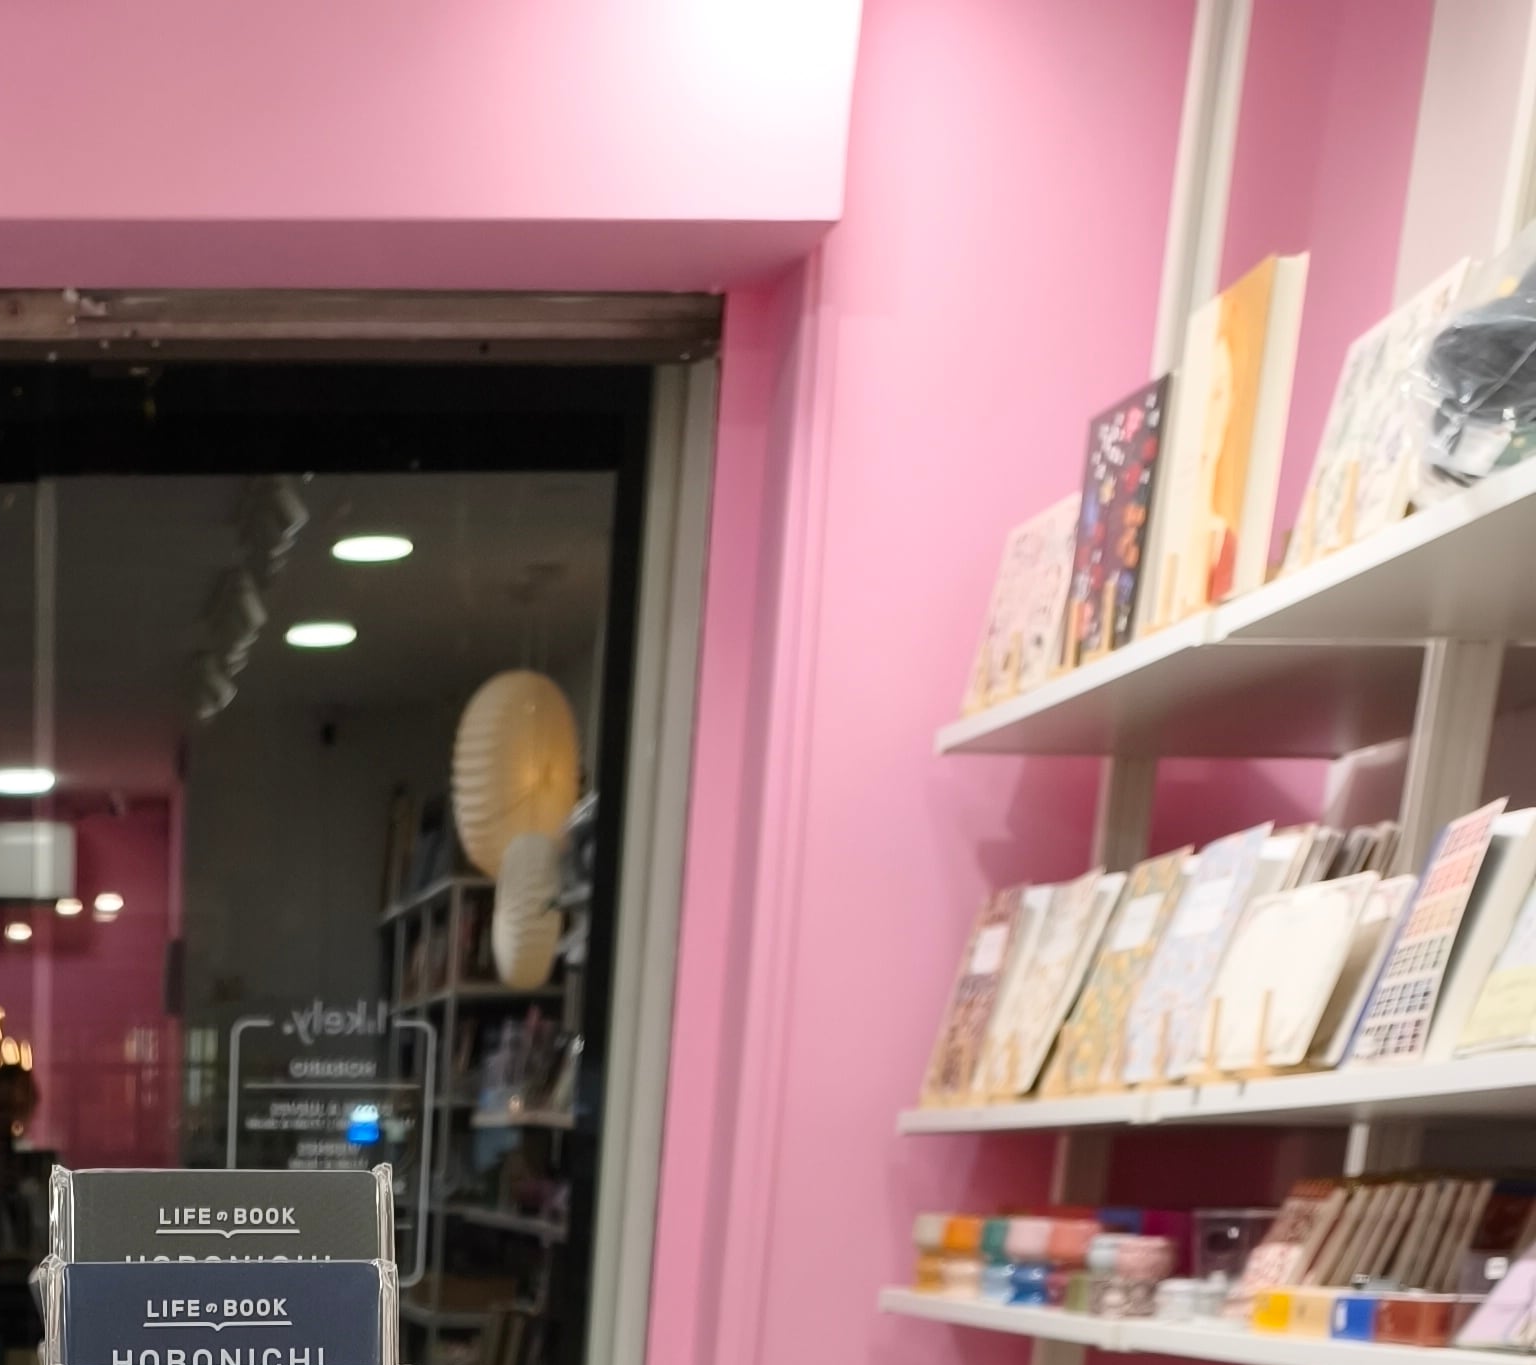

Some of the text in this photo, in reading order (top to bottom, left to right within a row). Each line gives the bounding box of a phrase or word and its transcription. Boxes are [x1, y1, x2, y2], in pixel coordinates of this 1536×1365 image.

[159, 1207, 211, 1225] LIFE
[233, 1207, 295, 1225] BOOK
[147, 1299, 200, 1318] LIFE
[223, 1298, 288, 1317] BOOK
